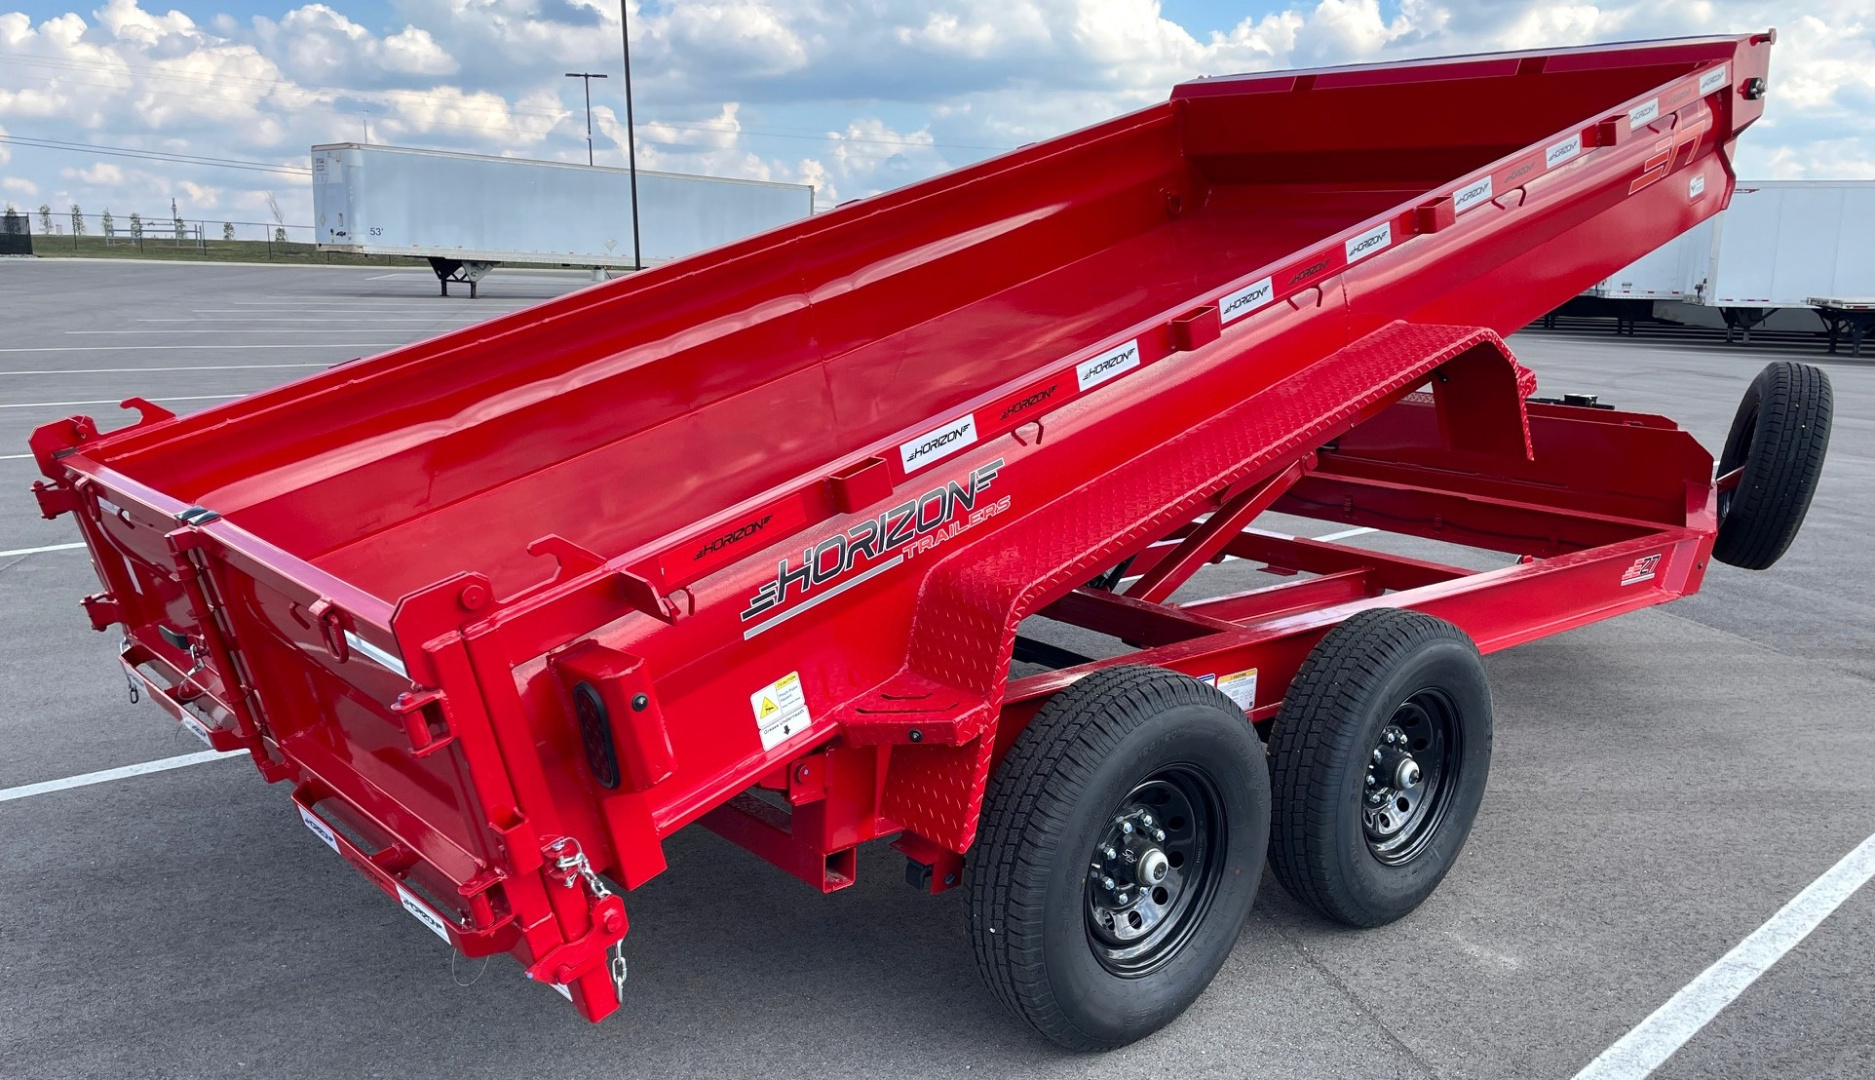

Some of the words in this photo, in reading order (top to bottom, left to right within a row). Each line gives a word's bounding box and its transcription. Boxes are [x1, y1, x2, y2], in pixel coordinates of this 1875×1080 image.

[1349, 231, 1387, 256] HORIZON
[1289, 259, 1330, 285] HORIZON
[1224, 286, 1269, 314] HORIZON
[1083, 348, 1135, 380] HORIZON
[1001, 385, 1057, 420] HORIZON
[907, 424, 970, 462] HORIZON
[695, 515, 772, 559] HORIZON
[746, 460, 1000, 616] HORIZON
[903, 497, 1011, 558] TRAILERS
